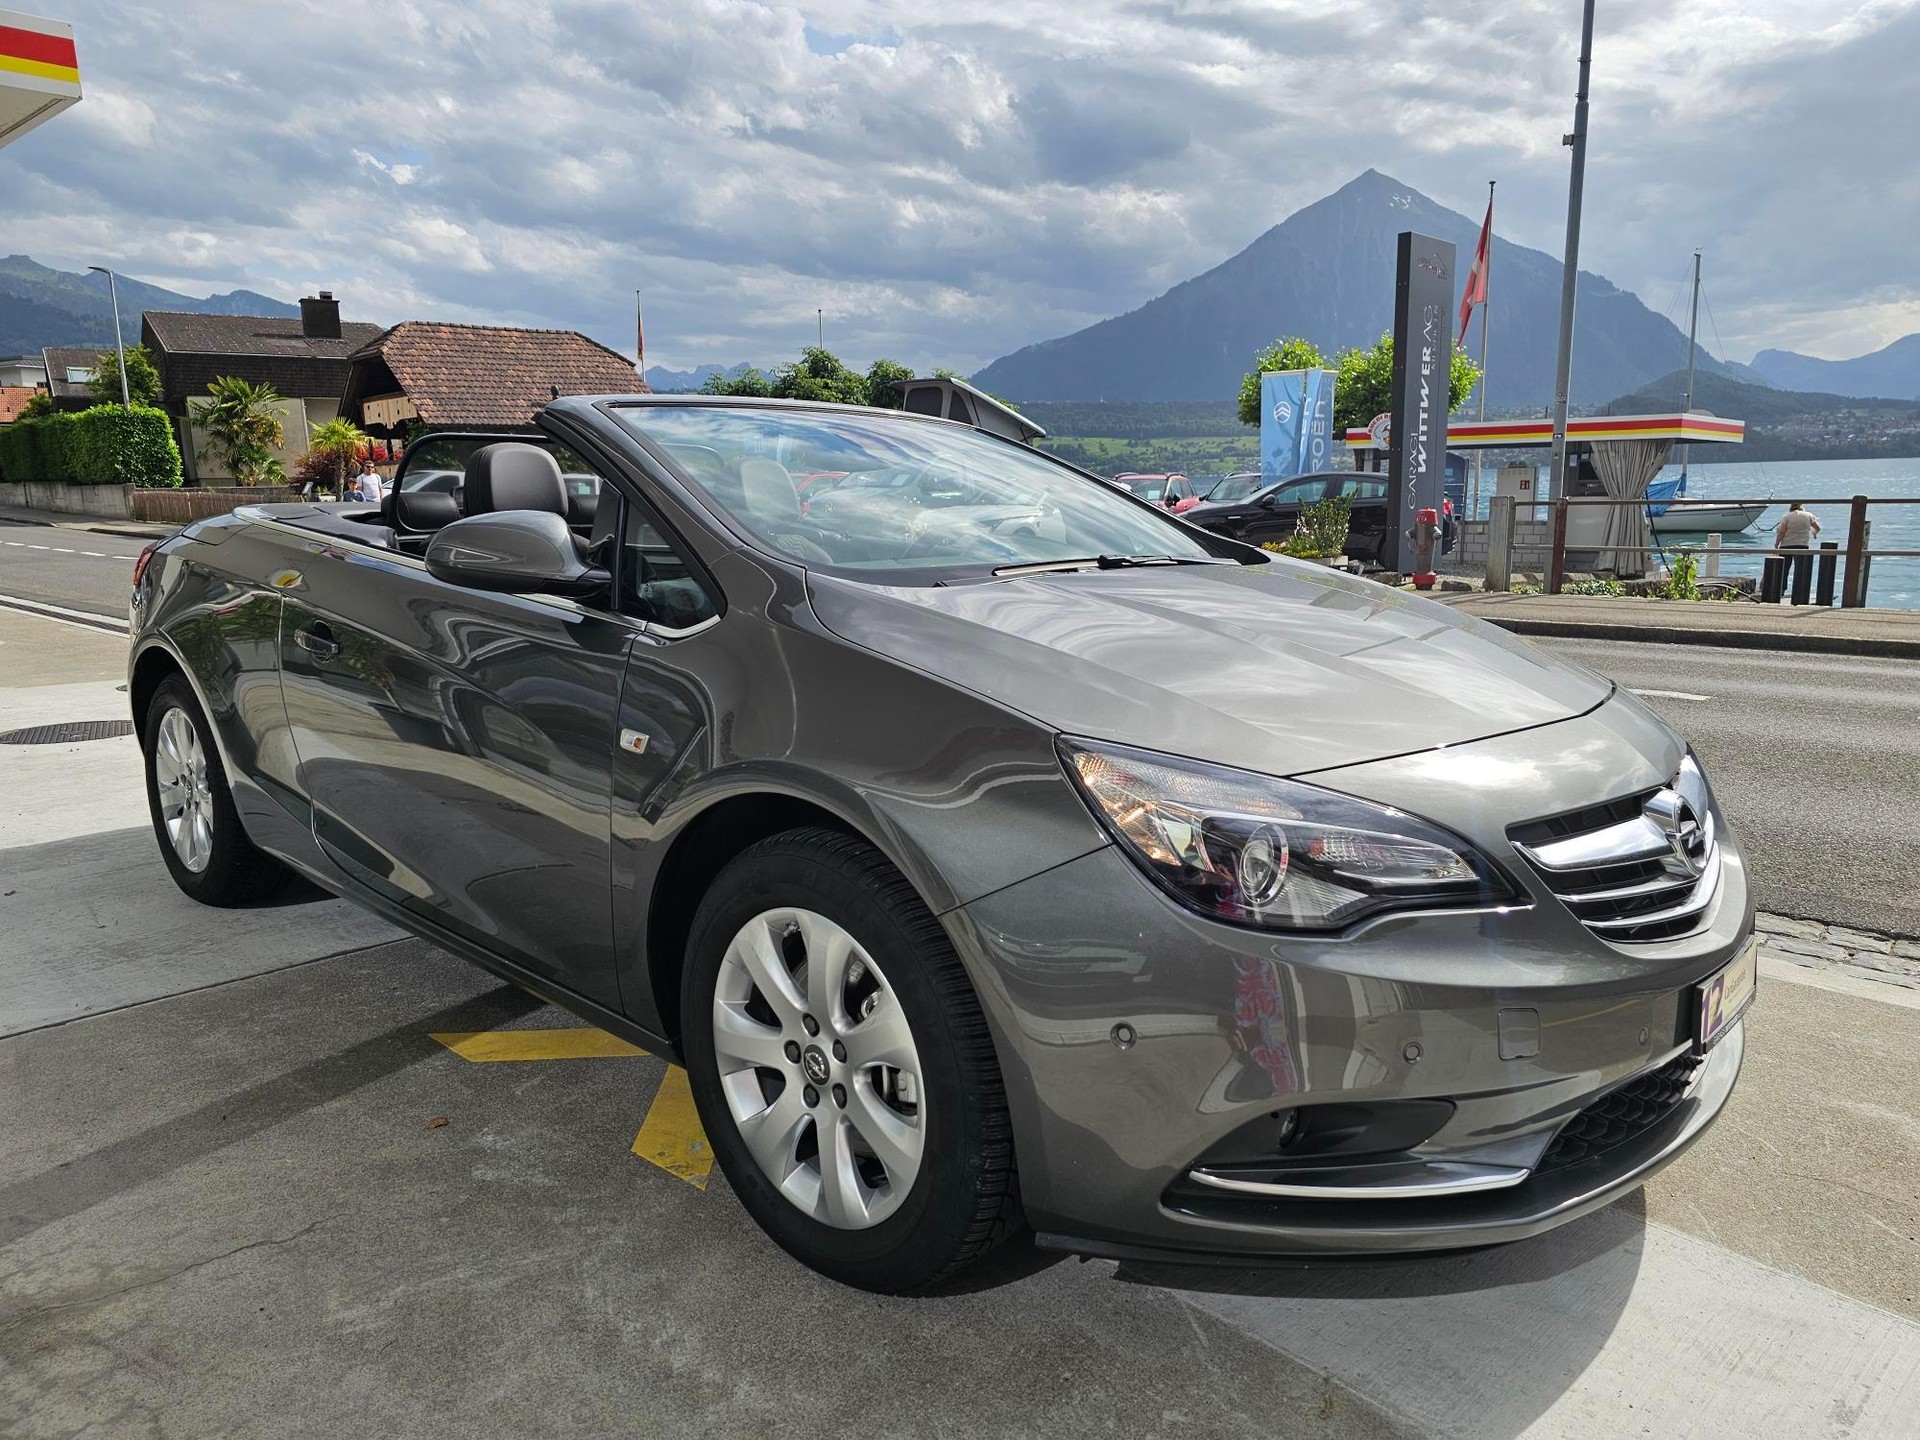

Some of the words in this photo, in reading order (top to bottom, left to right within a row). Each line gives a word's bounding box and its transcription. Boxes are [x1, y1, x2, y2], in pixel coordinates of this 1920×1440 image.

[1424, 304, 1434, 344] AG
[1418, 347, 1432, 473] WITTWER
[1408, 427, 1419, 509] GARAGE
